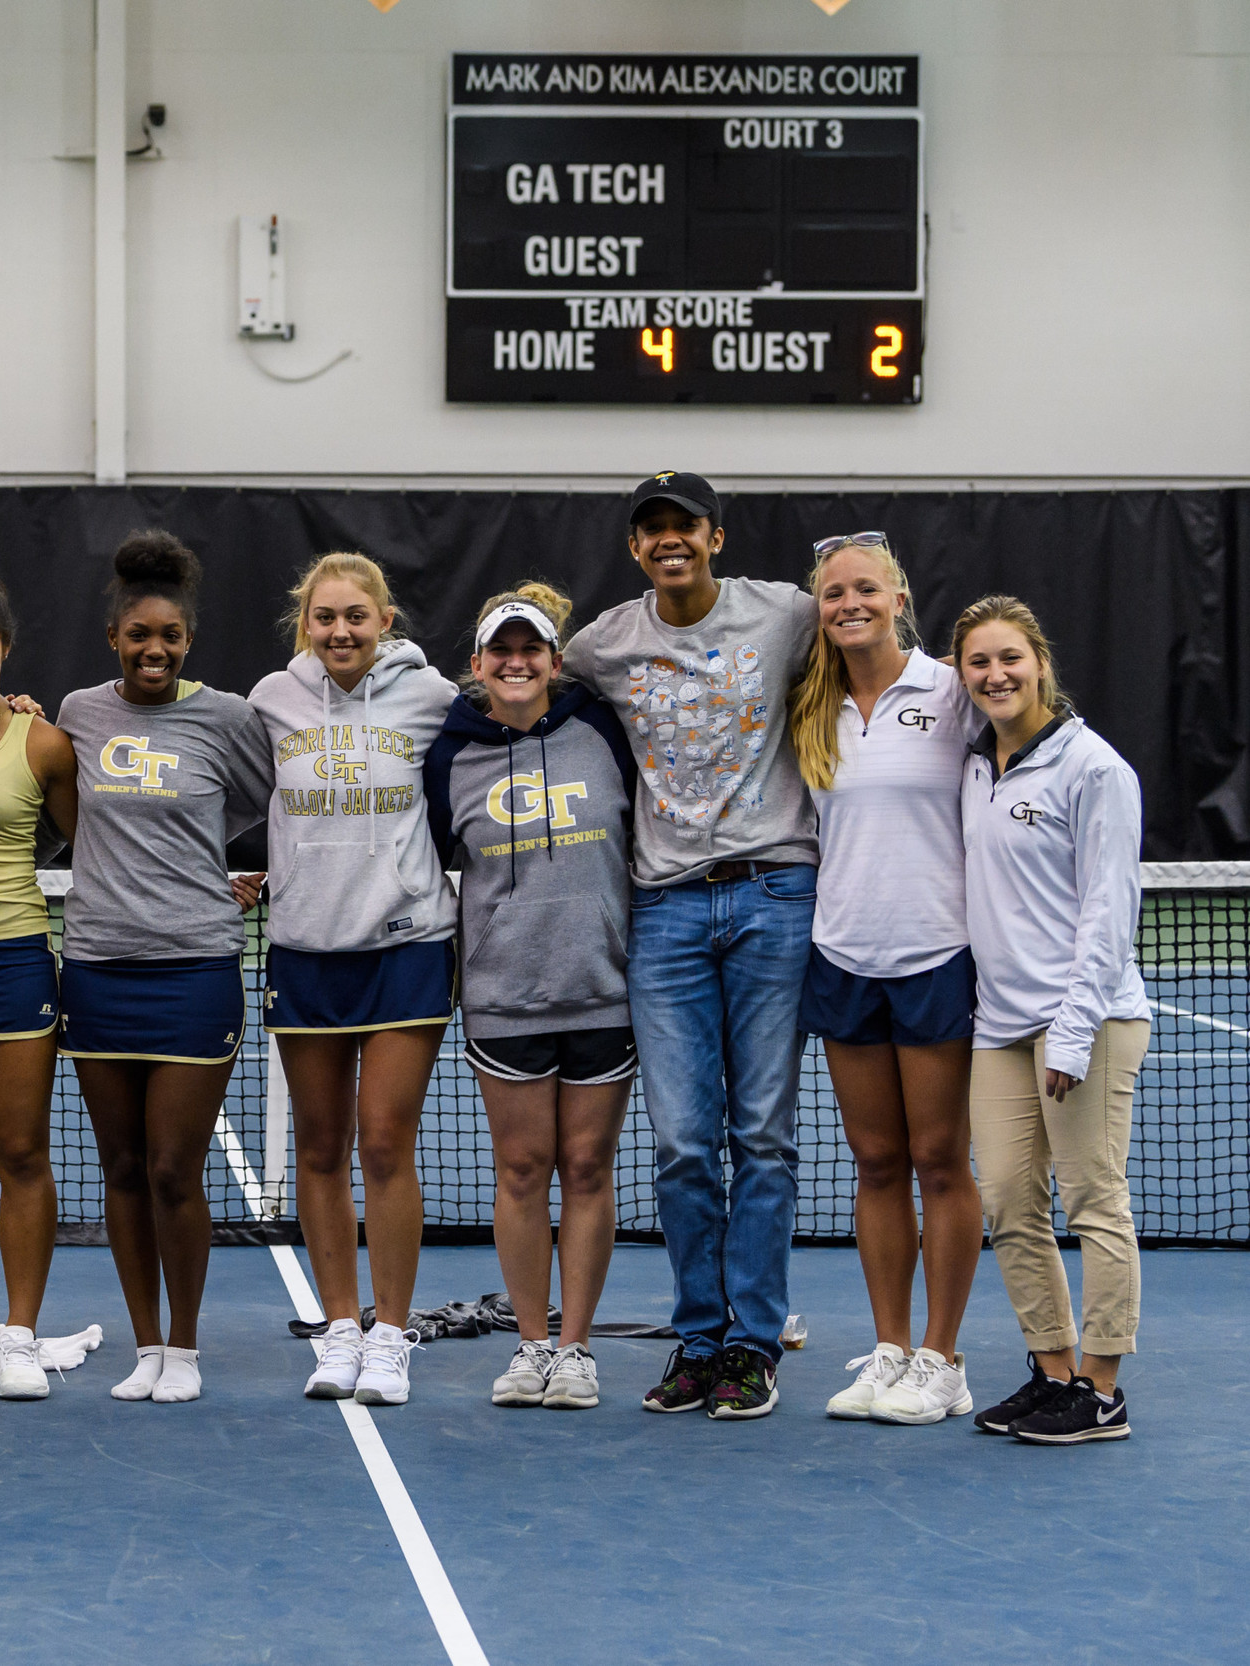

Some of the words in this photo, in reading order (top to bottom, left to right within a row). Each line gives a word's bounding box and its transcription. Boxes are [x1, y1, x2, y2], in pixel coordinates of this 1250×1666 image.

[465, 64, 540, 92] MARK
[544, 64, 603, 93] AND
[610, 64, 655, 94] KIM
[658, 64, 815, 95] ALEXANDER
[819, 65, 906, 95] COURT
[724, 119, 818, 149] COURT
[826, 119, 844, 149] 3
[506, 163, 559, 204] GA
[566, 163, 665, 204] TECH
[524, 236, 643, 277] GUEST
[565, 297, 647, 329] TEAM
[653, 297, 753, 328] SCORE
[494, 330, 596, 371] HOME
[642, 328, 673, 373] 4
[712, 331, 831, 373] GUEST
[871, 325, 903, 378] 2
[897, 708, 936, 732] GT
[99, 735, 180, 788] GT
[277, 725, 355, 767] GEORGIA
[313, 753, 366, 785] GT
[94, 784, 138, 794] WOMEN'S
[140, 787, 178, 798] TENNIS
[279, 788, 335, 816] YELLOW
[486, 769, 588, 829] GT
[1009, 801, 1043, 826] GT
[479, 837, 549, 857] WOMEN'S
[552, 828, 607, 847] TENNIS
